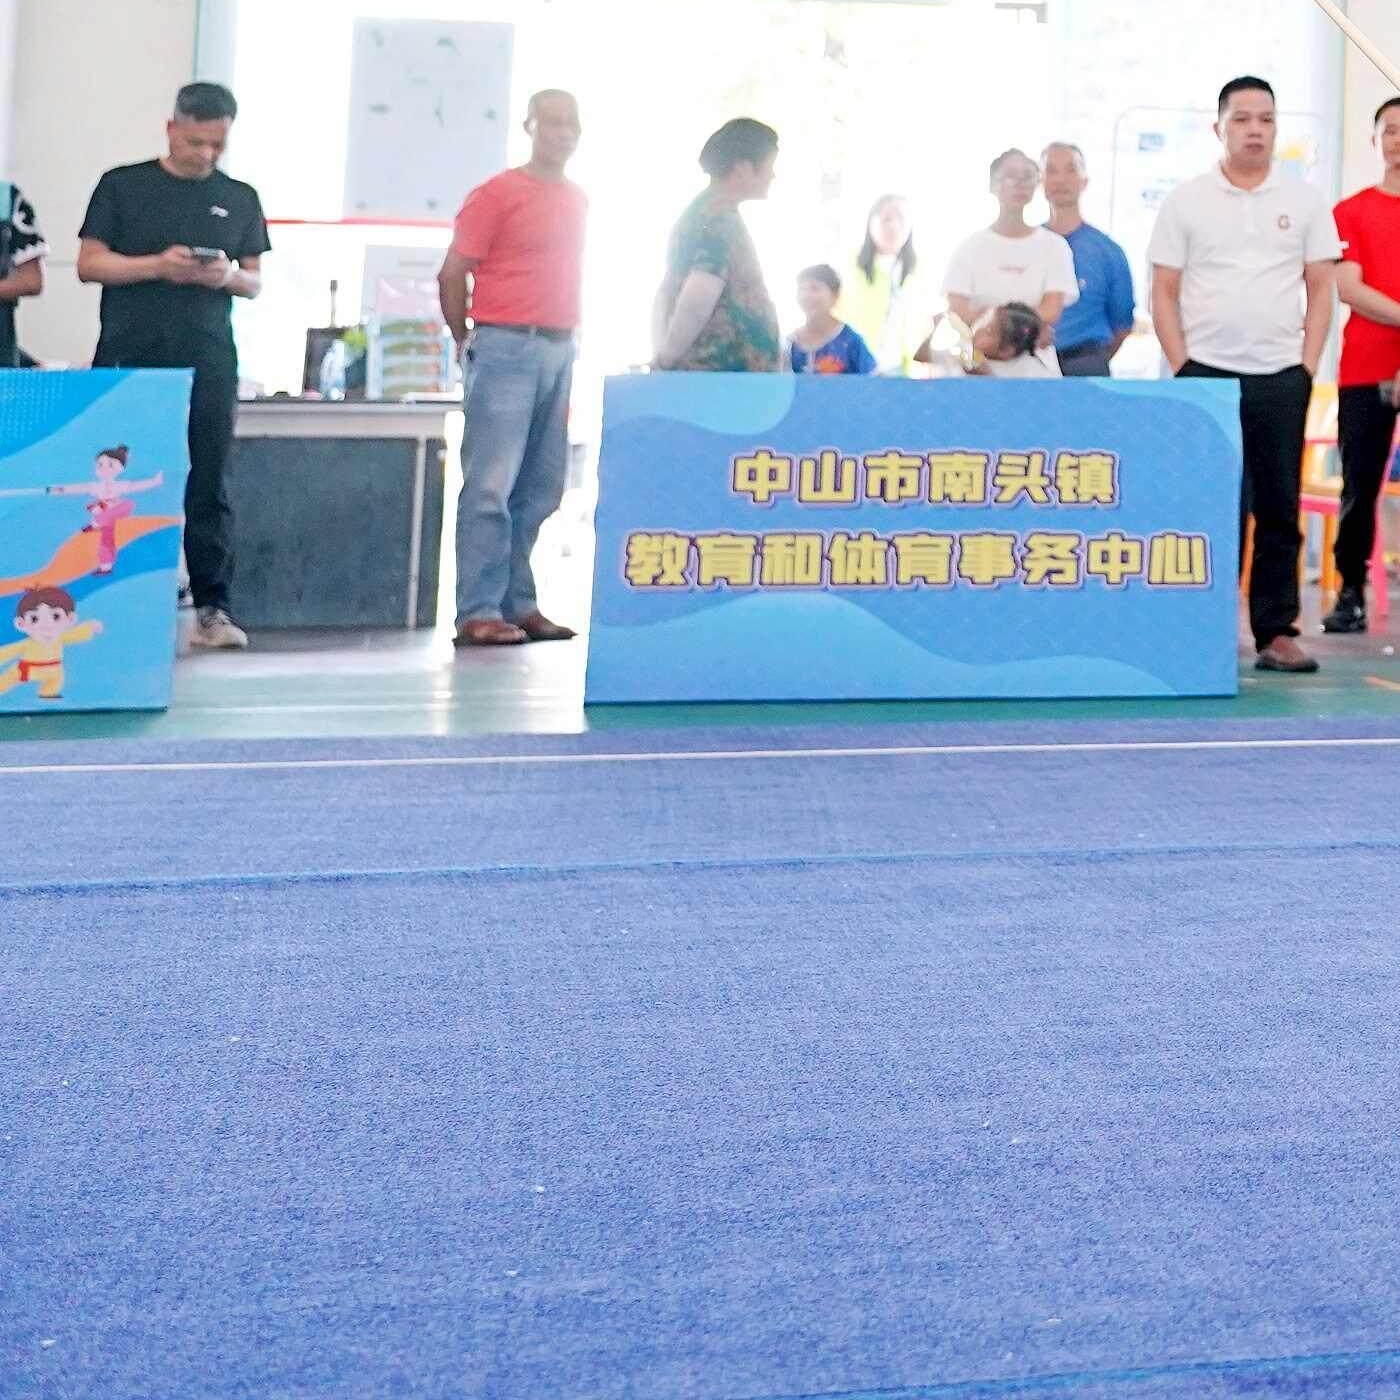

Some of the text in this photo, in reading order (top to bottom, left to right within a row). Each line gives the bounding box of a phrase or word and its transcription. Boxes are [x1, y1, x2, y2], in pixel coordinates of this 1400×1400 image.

[732, 449, 1119, 506] 中山市南头镇
[624, 530, 1212, 590] 教育和体育事务中心
